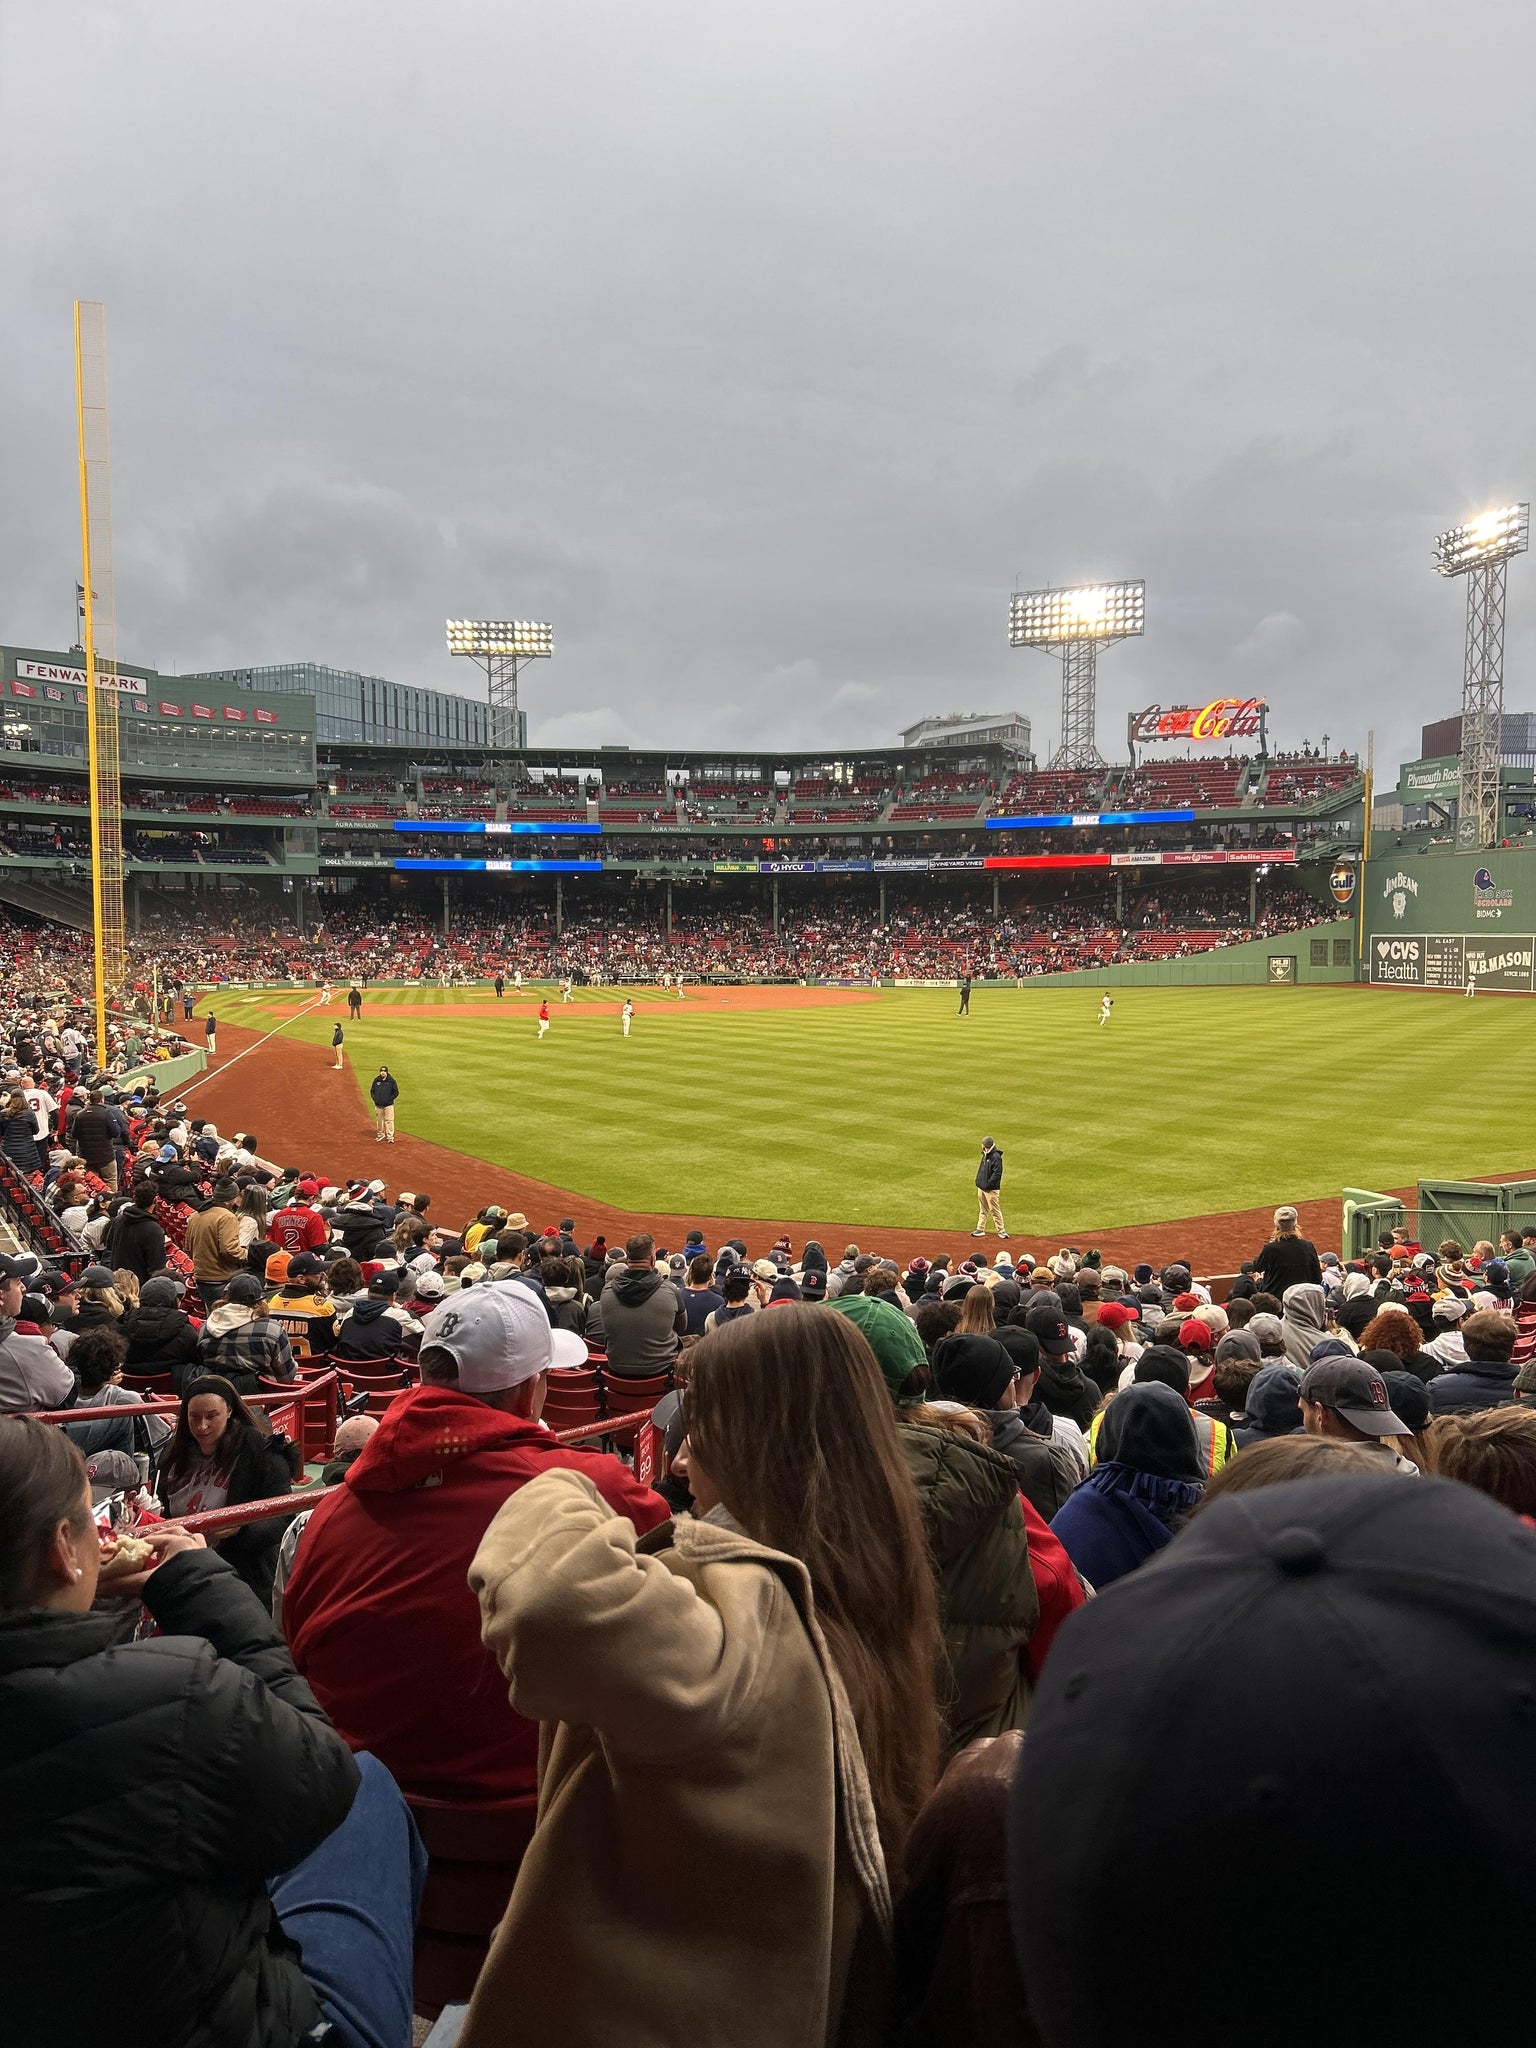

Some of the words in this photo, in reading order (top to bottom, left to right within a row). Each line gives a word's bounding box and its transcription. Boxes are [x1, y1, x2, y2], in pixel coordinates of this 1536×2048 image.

[26, 664, 88, 683] FENWAY
[99, 675, 139, 691] PARK
[1406, 770, 1442, 786] Plymouth
[1442, 766, 1461, 781] Rock
[716, 863, 739, 871] SULLIVAN
[1330, 874, 1354, 888] Gulf
[1477, 890, 1494, 899] RED
[1496, 890, 1513, 899] SOX
[1477, 898, 1512, 907] SCHOLARS
[1476, 910, 1496, 918] BIDMC
[1390, 942, 1419, 960] CVS
[1378, 961, 1418, 980] Health
[276, 1214, 308, 1228] TURNER
[284, 1228, 301, 1252] 2
[436, 1312, 460, 1338] B
[272, 1422, 288, 1435] BOX
[640, 1455, 652, 1482] 89
